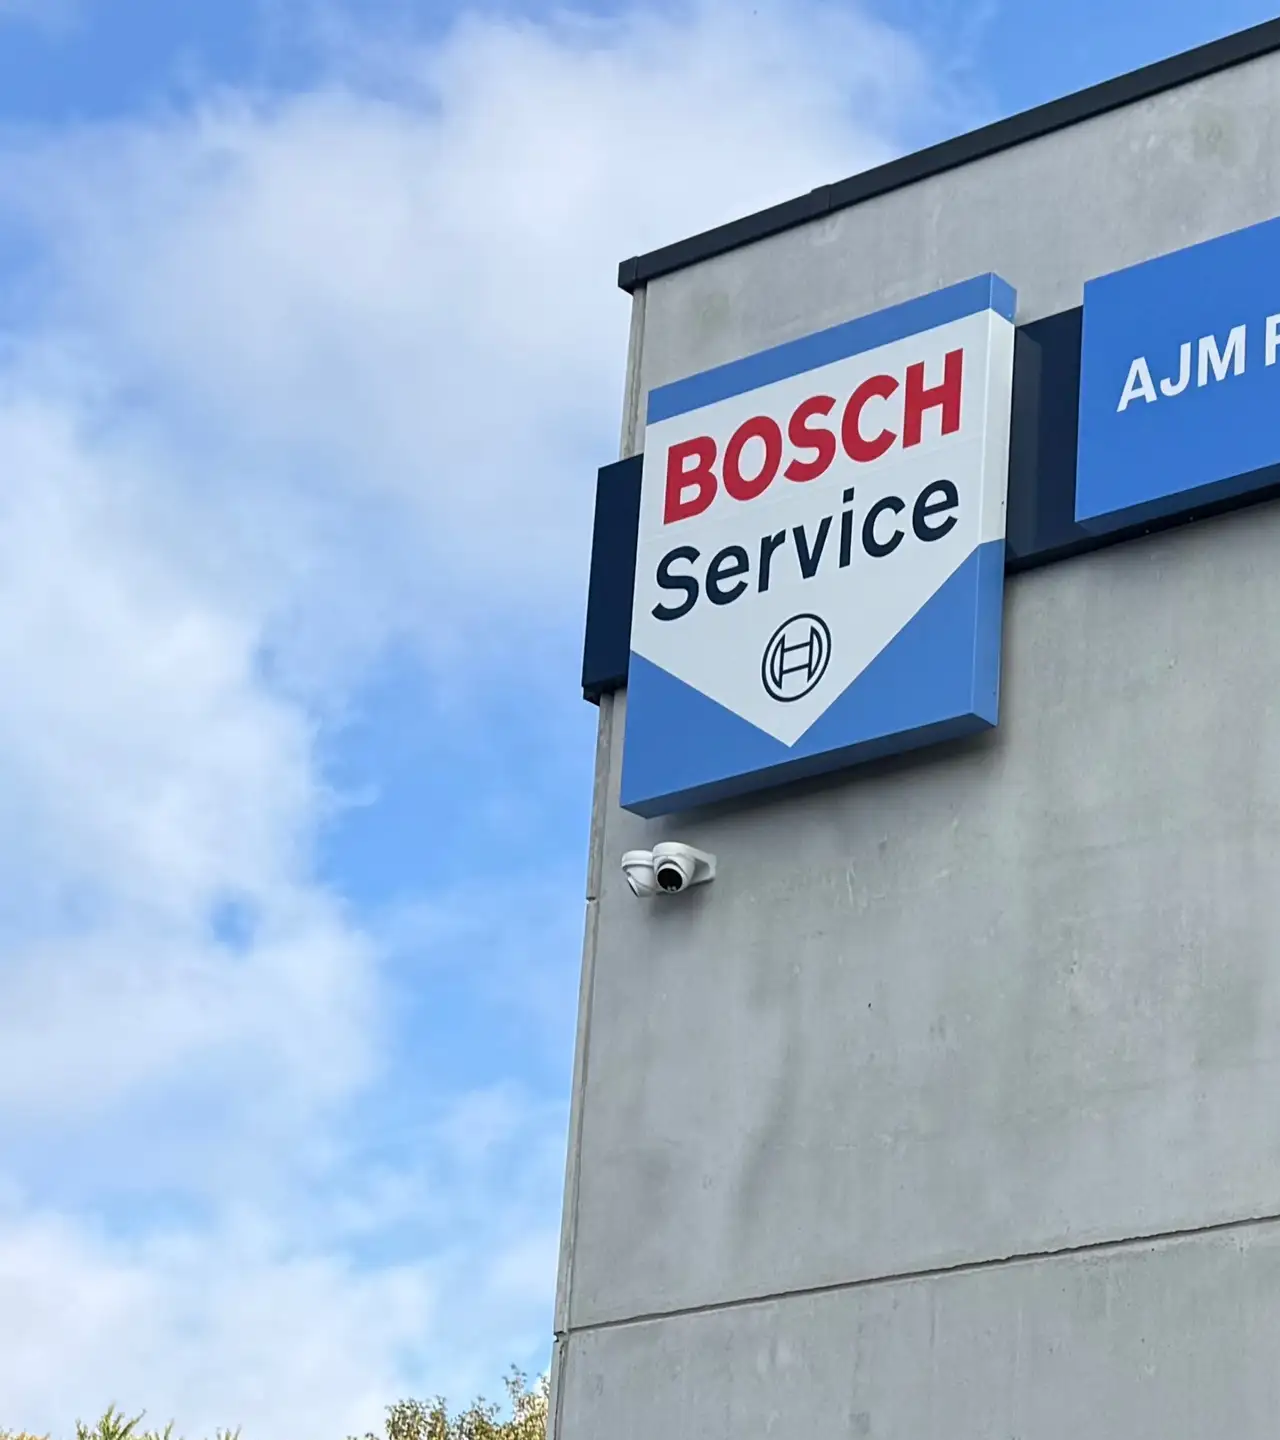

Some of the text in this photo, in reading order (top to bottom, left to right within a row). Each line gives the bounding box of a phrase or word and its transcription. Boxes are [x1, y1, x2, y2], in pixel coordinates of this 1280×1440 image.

[663, 348, 964, 525] BOSCH
[1117, 324, 1247, 412] AJM
[651, 479, 959, 621] Service
